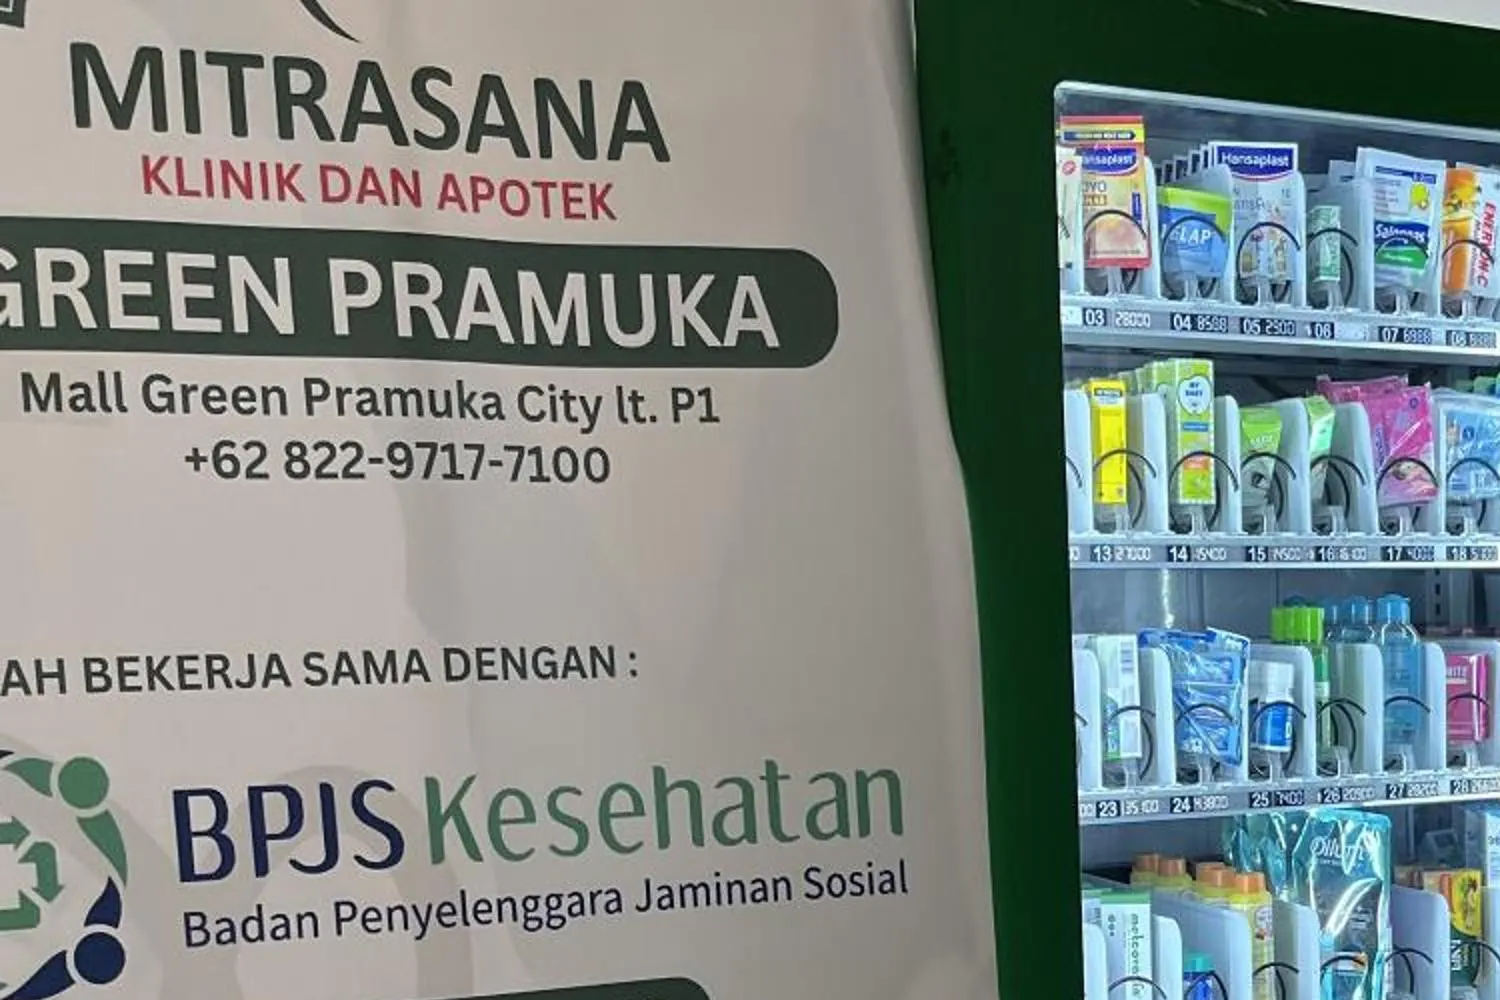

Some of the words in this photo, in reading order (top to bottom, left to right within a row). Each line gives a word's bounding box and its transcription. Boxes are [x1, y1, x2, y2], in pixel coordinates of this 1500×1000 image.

[69, 41, 671, 163] MITRASANA
[141, 154, 305, 203] KLINIK
[319, 165, 422, 208] DAN
[437, 172, 618, 222] APOTEK
[328, 257, 781, 349] PRAMUKA
[1085, 309, 1105, 326] 03
[1172, 314, 1192, 331] 04
[1381, 327, 1398, 342] 07
[20, 371, 127, 416] Mall
[141, 374, 288, 418] Green
[304, 378, 505, 423] Pramuka
[517, 385, 603, 435] City
[672, 388, 720, 425] P1
[184, 440, 268, 483] +62
[284, 441, 610, 485] 822-9717-7100
[1094, 547, 1112, 562] 13
[1170, 547, 1190, 563] 14
[1248, 547, 1267, 562] 15
[1386, 547, 1401, 562] 17
[83, 653, 290, 695] BEKERJA
[303, 649, 431, 688] SAMA
[443, 645, 617, 685] DENGAN
[1173, 797, 1192, 813] 24
[1252, 792, 1269, 807] 25
[1099, 801, 1118, 818] 23
[172, 778, 405, 884] BPJS
[423, 758, 906, 866] Kesehatan
[183, 906, 320, 949] Badan
[334, 884, 624, 940] Penyelenggara
[636, 870, 792, 915] Jaminan
[804, 860, 909, 903] Sosial
